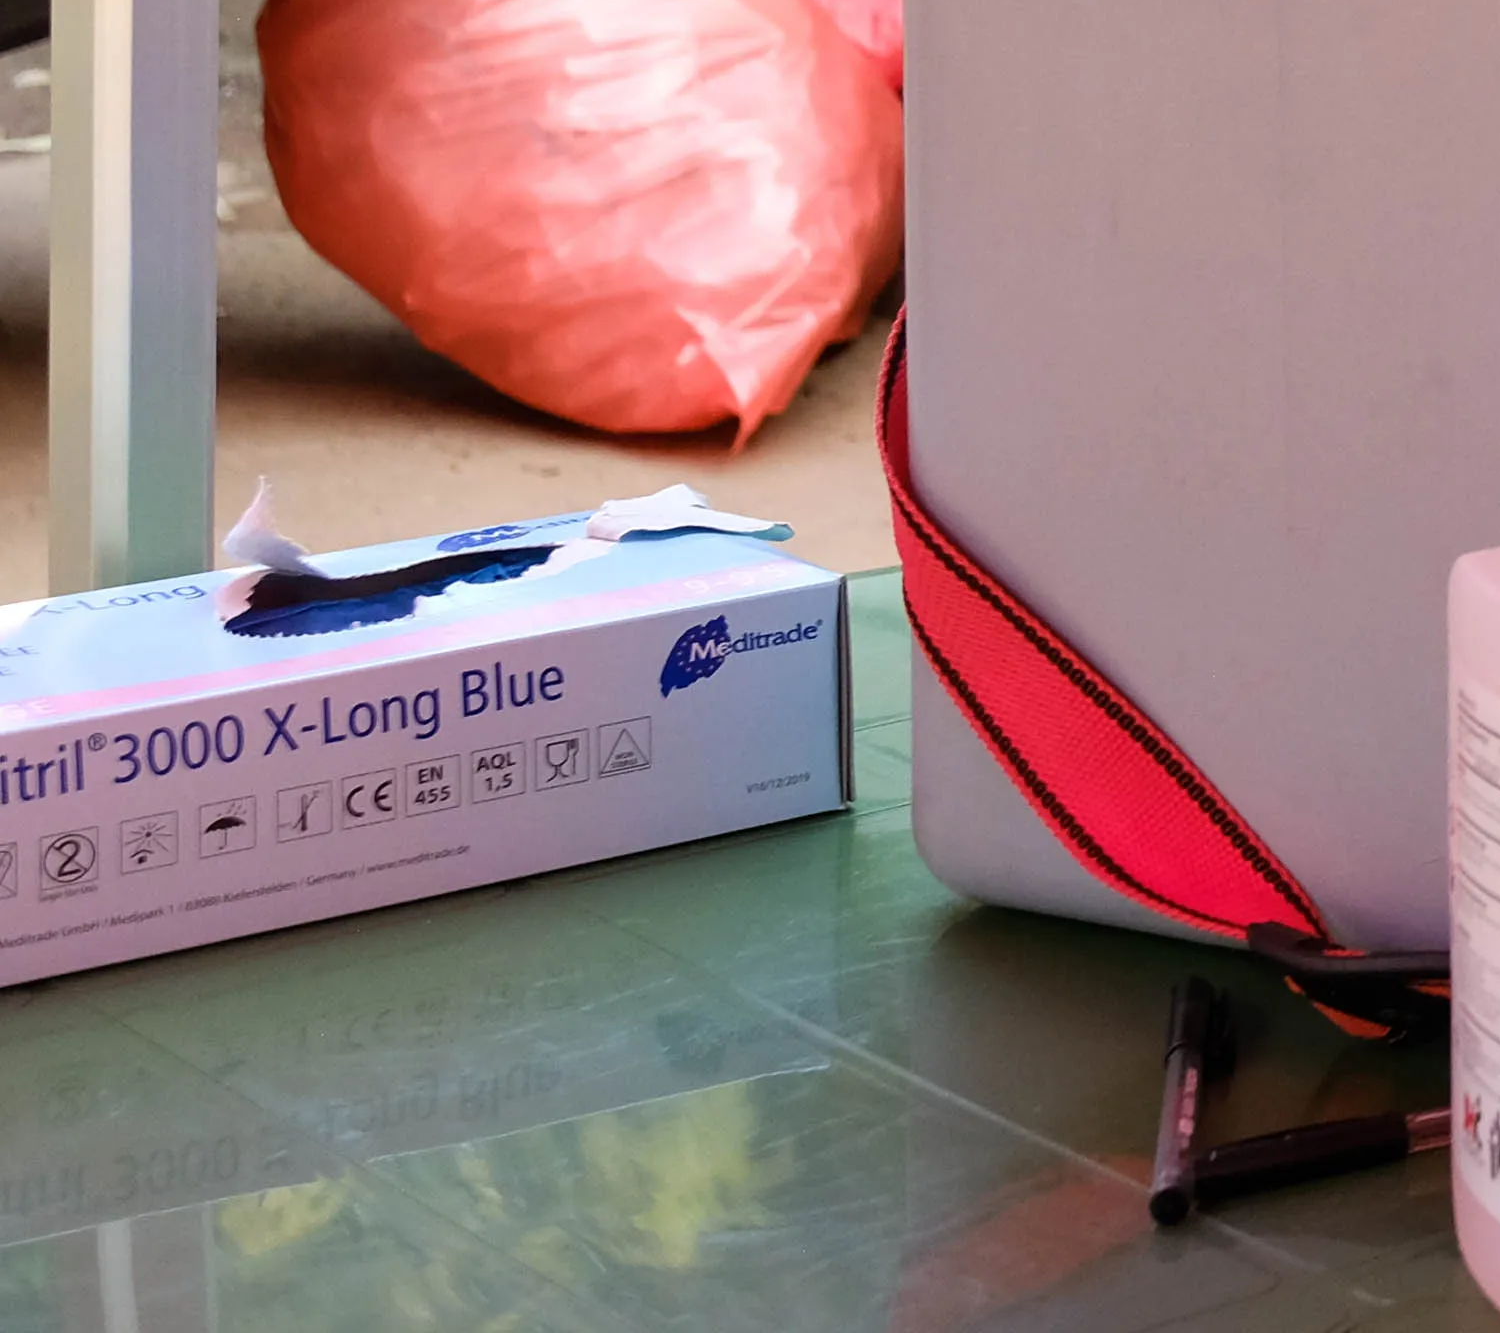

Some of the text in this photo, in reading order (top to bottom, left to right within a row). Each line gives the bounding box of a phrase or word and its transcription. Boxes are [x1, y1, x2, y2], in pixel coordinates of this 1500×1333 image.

[0, 661, 565, 805] itril® 3000 X-Long Blue
[476, 752, 516, 772] AQL
[418, 765, 444, 784] EN
[485, 773, 513, 793] 1,5
[346, 780, 393, 817] CE
[414, 785, 450, 805] 455
